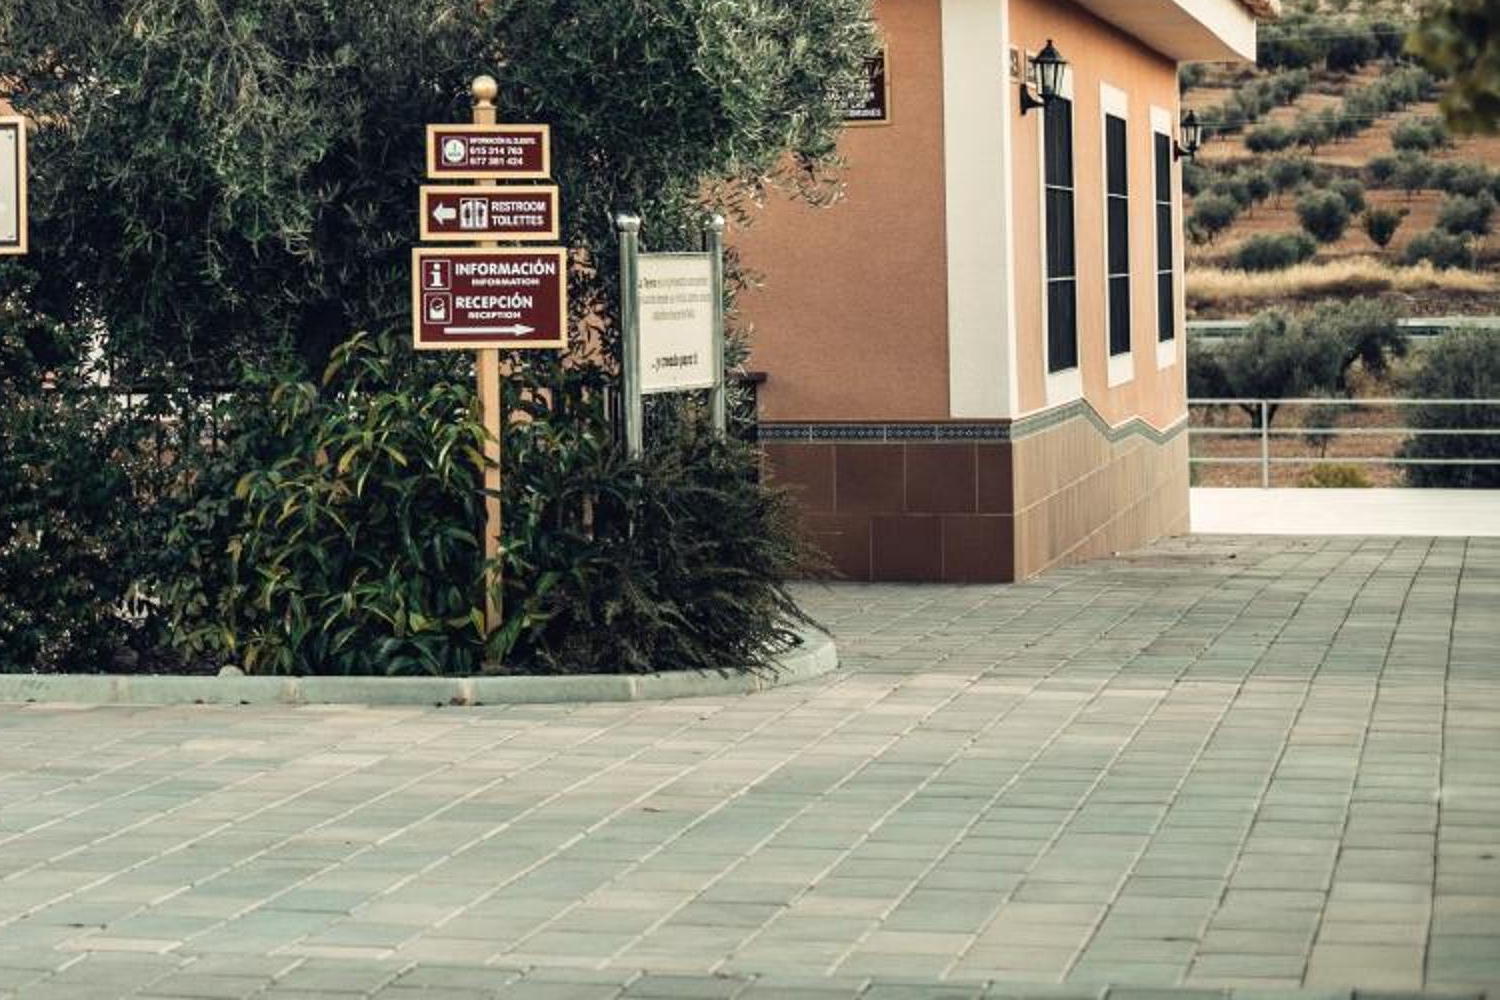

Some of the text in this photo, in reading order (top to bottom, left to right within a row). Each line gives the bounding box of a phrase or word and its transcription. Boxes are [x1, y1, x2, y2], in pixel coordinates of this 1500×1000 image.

[491, 202, 547, 212] RESTROOM
[491, 215, 544, 226] TOILETTES
[455, 257, 556, 275] INFORMACIÓN
[471, 277, 540, 287] INFORMATION
[455, 291, 533, 309] RECEPCIÓN
[468, 311, 521, 320] RECEPTION
